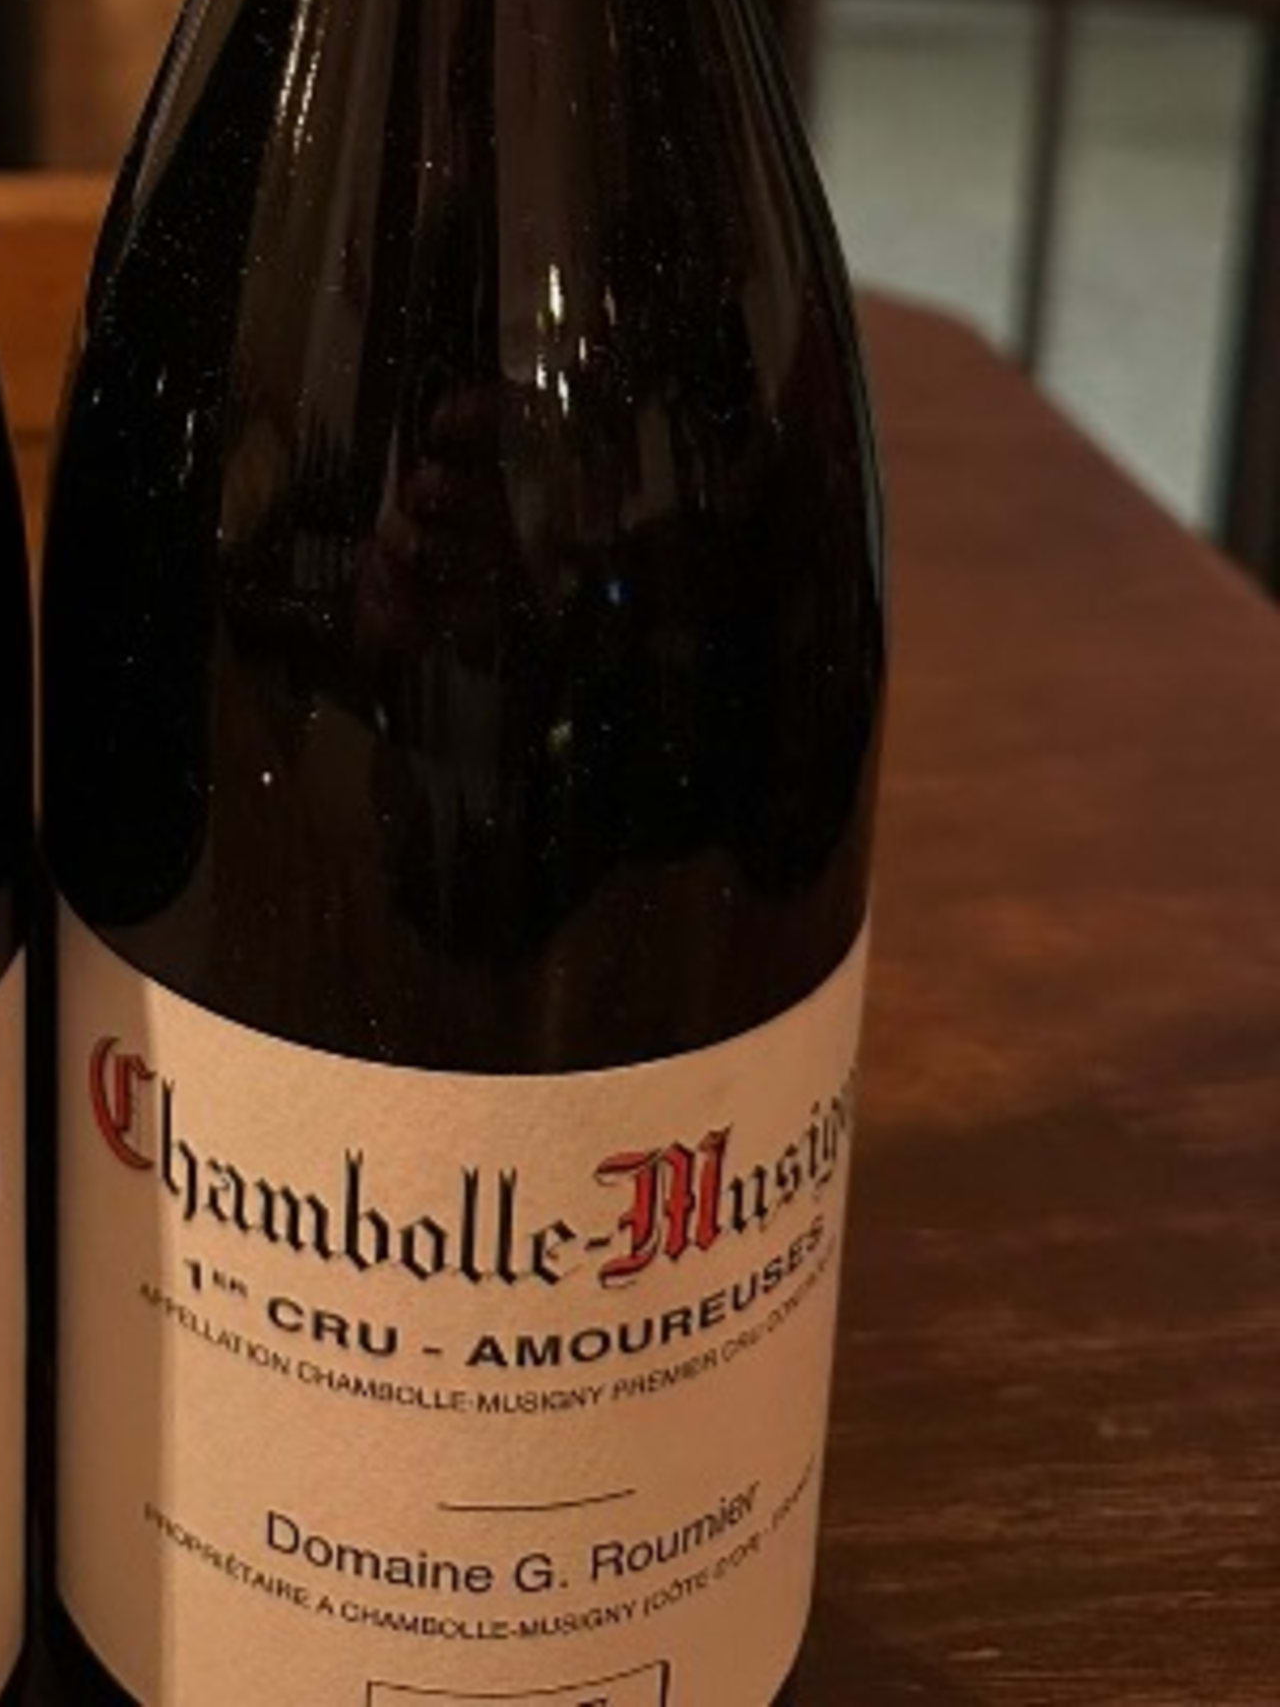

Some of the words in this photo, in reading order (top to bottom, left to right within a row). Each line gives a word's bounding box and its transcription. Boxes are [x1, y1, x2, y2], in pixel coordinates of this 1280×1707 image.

[90, 1036, 852, 1289] Chambolle-Musig
[139, 1282, 291, 1376] APPELLATION
[296, 1358, 605, 1416] CHAMBOLLE-MUSIGNY
[612, 1346, 718, 1401] PREMIER
[266, 1296, 398, 1358] CRU
[465, 1214, 825, 1368] AMOUREUSES
[266, 1508, 494, 1594] Domaine
[513, 1551, 570, 1595] G.
[589, 1479, 761, 1584] Roumier
[339, 1599, 637, 1641] CHAMBOLLE-MUSIGNY
